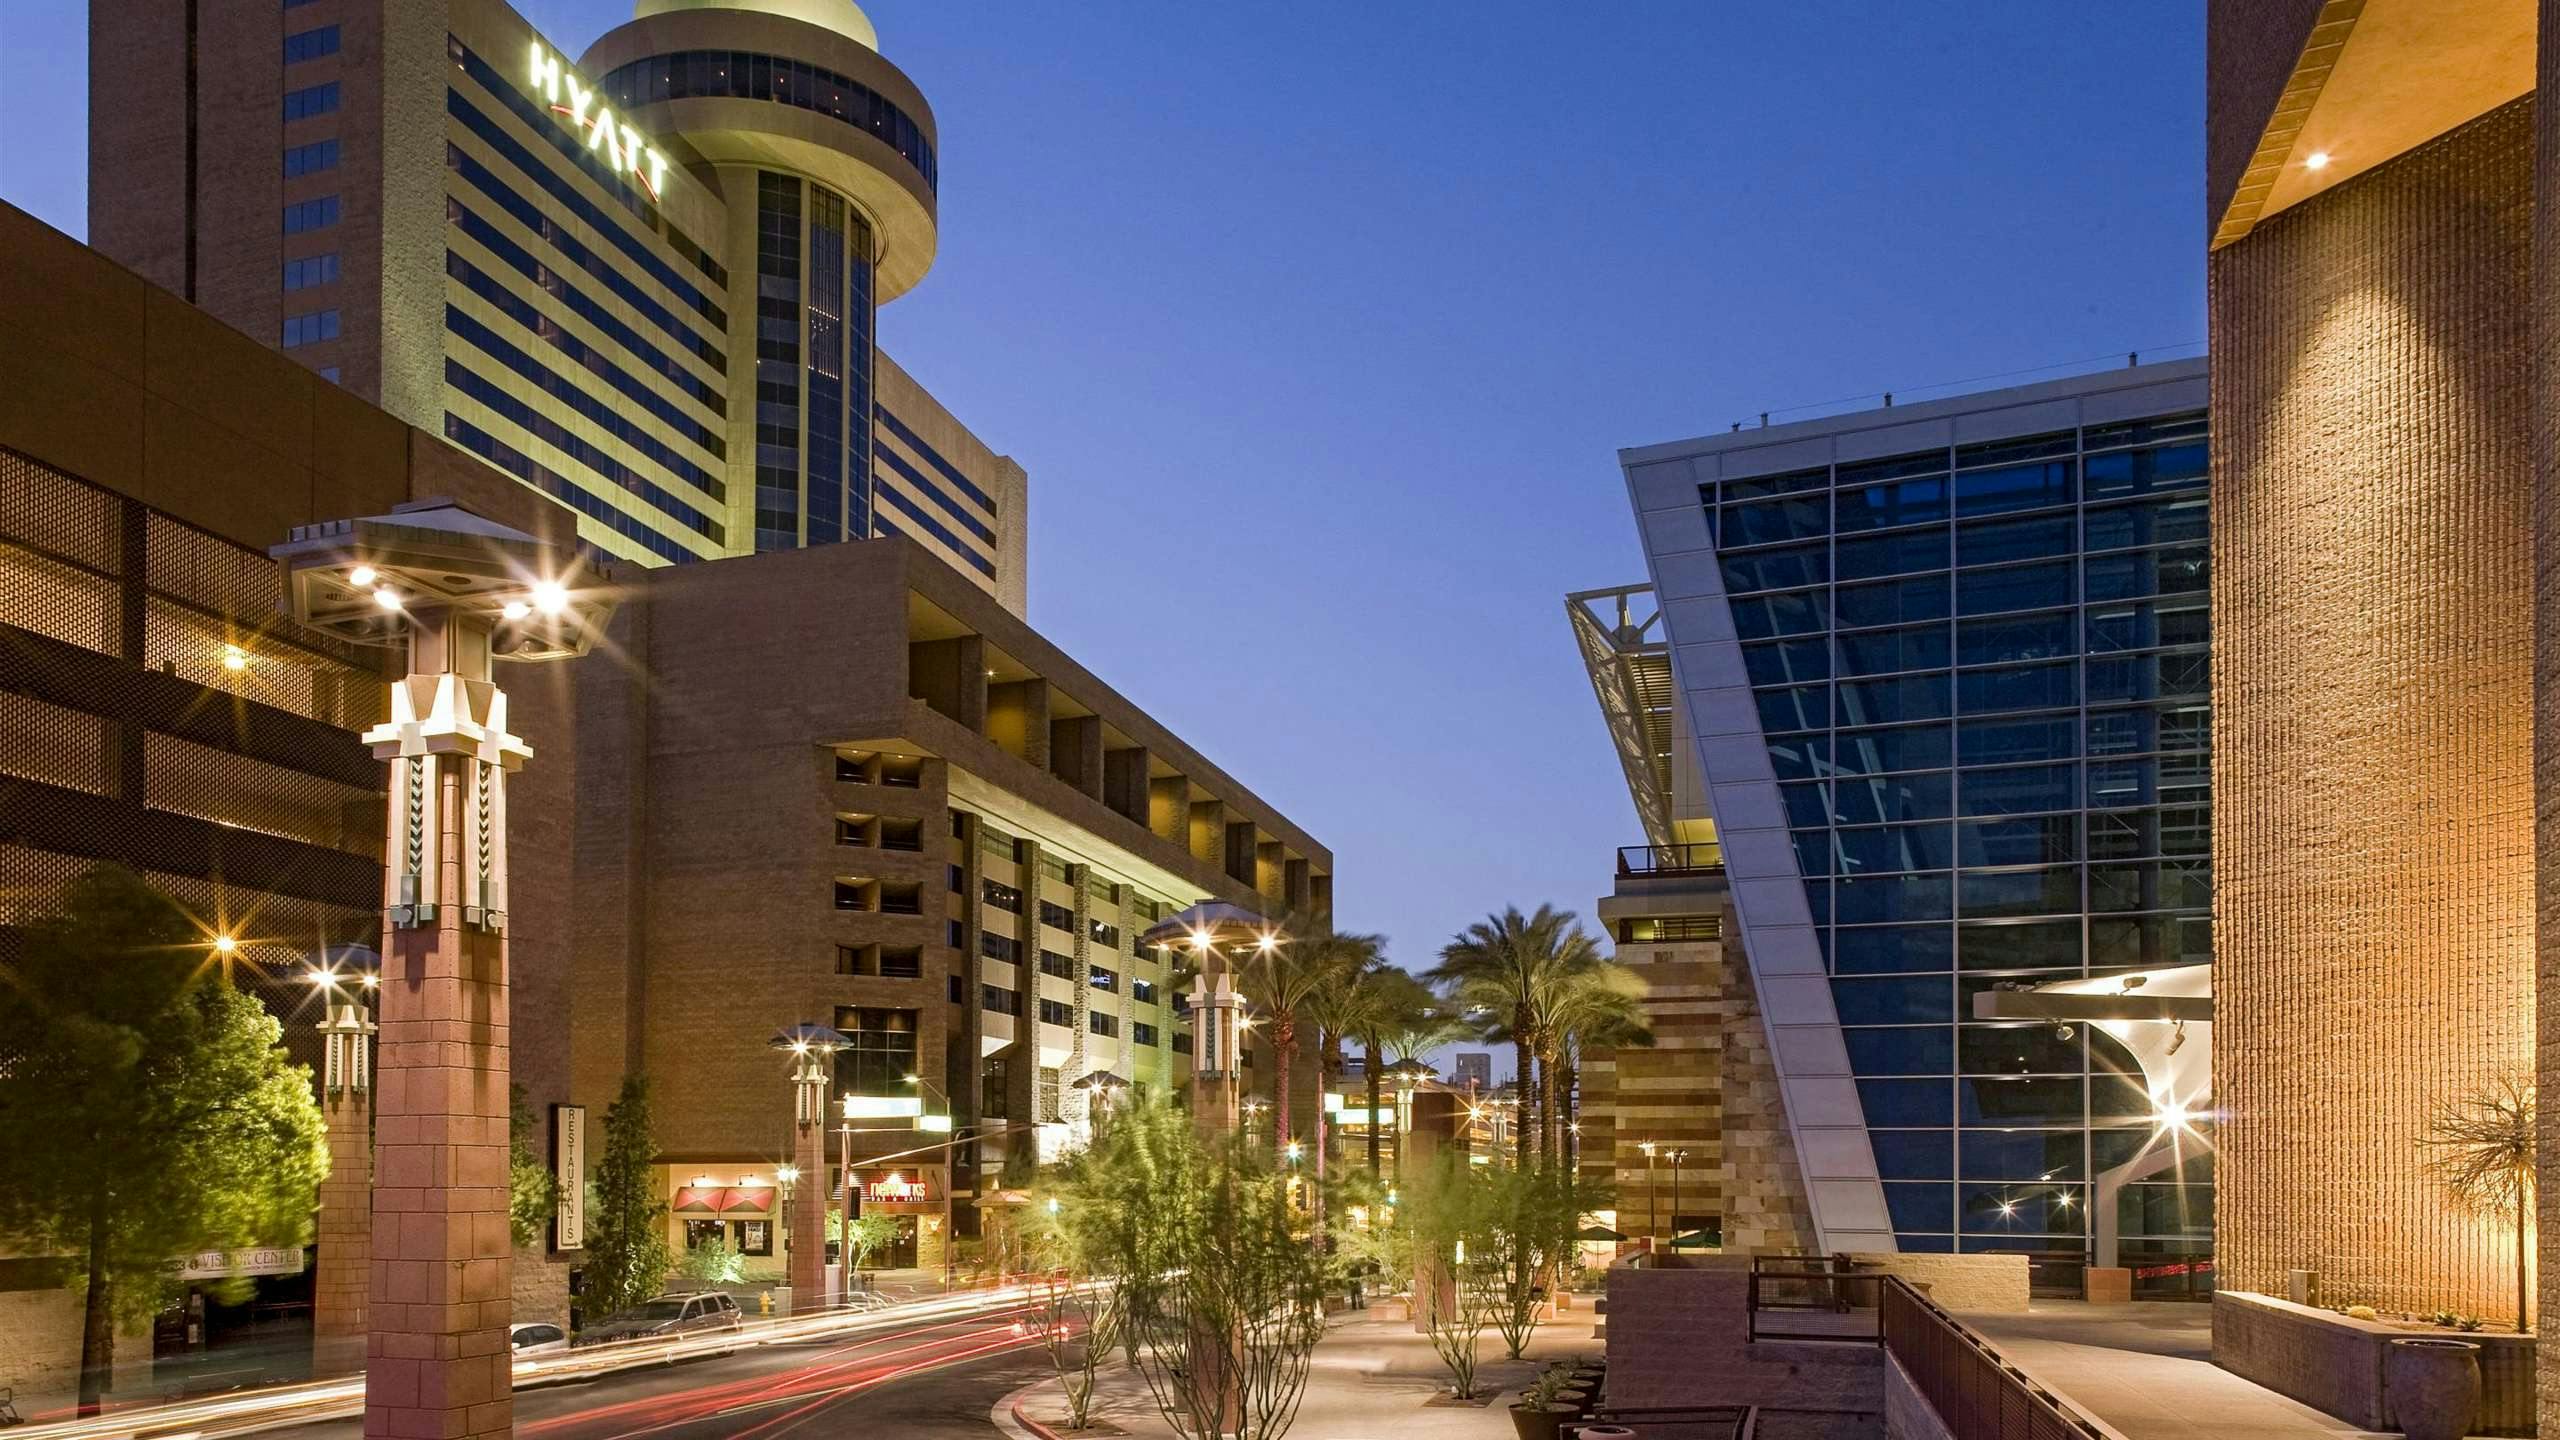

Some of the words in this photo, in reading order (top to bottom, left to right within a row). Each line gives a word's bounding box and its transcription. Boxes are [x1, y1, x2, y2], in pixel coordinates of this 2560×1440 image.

[530, 41, 668, 196] HYATT
[567, 1108, 575, 1239] RESTAURANTS
[201, 1253, 251, 1268] VISIOR
[254, 1249, 300, 1265] CENTER
